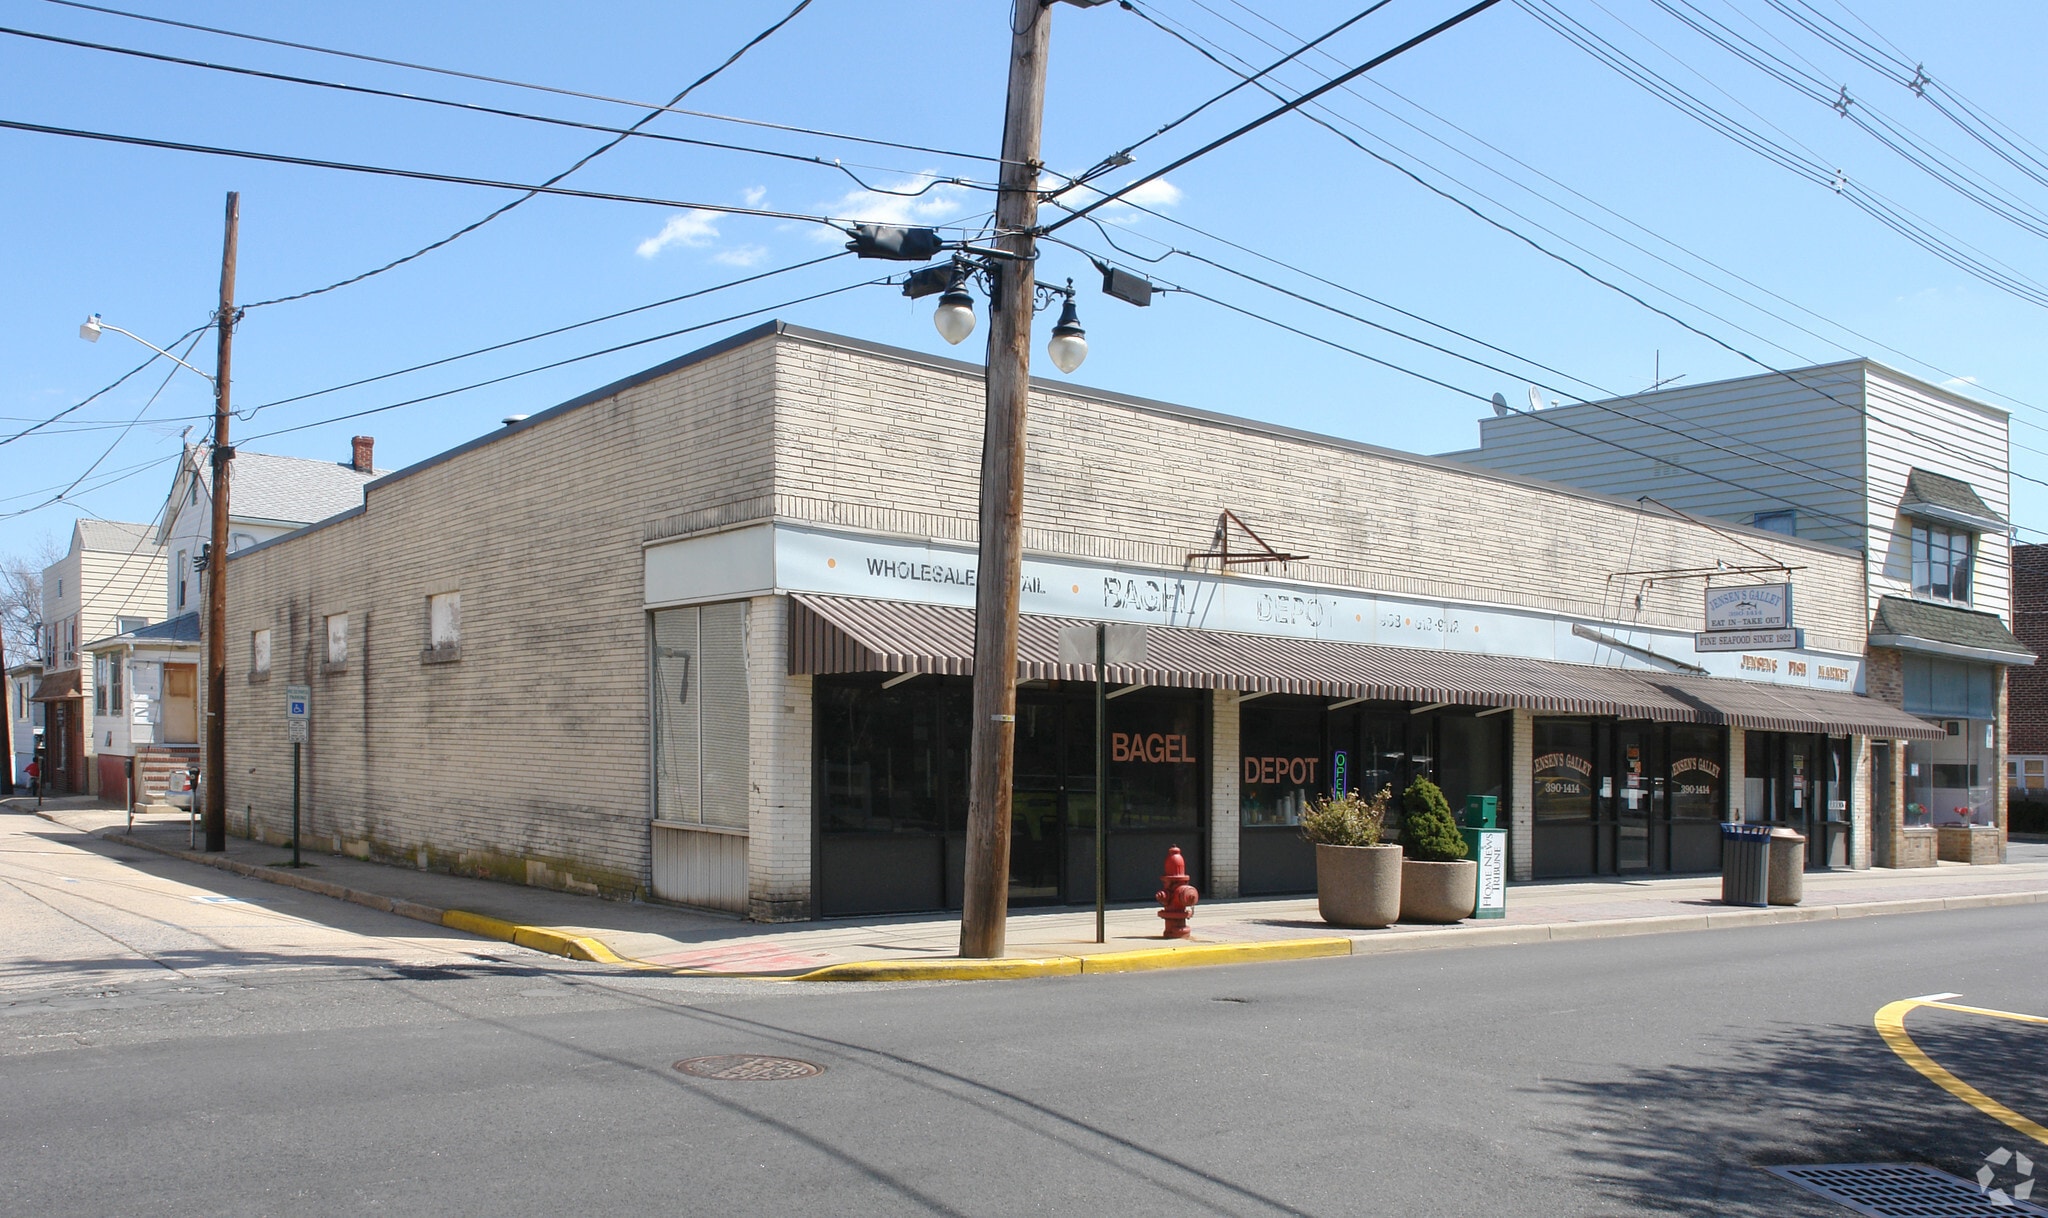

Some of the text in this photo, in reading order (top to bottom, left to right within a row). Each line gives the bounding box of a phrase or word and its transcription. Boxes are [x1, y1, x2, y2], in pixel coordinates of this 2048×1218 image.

[866, 558, 976, 586] WHOLESALE
[1749, 590, 1783, 607] GALLEY
[1711, 619, 1725, 627] EAT
[1765, 616, 1780, 624] OUT
[1700, 633, 1791, 646] FINE SEAFOOD SINCE 1922
[1818, 665, 1849, 682] MARKET
[1111, 732, 1196, 763] BAGEL
[1244, 756, 1318, 785] DEPOT
[1534, 752, 1592, 777] ENSEN'S GALLEY
[1672, 757, 1721, 778] ENSEN'S GALLEY
[1335, 753, 1345, 801] OPEN
[1545, 782, 1580, 793] 390-1414
[1681, 785, 1710, 795] 390-1414
[1483, 833, 1493, 906] HOME NEWS
[1492, 847, 1501, 890] TRIBUNE
